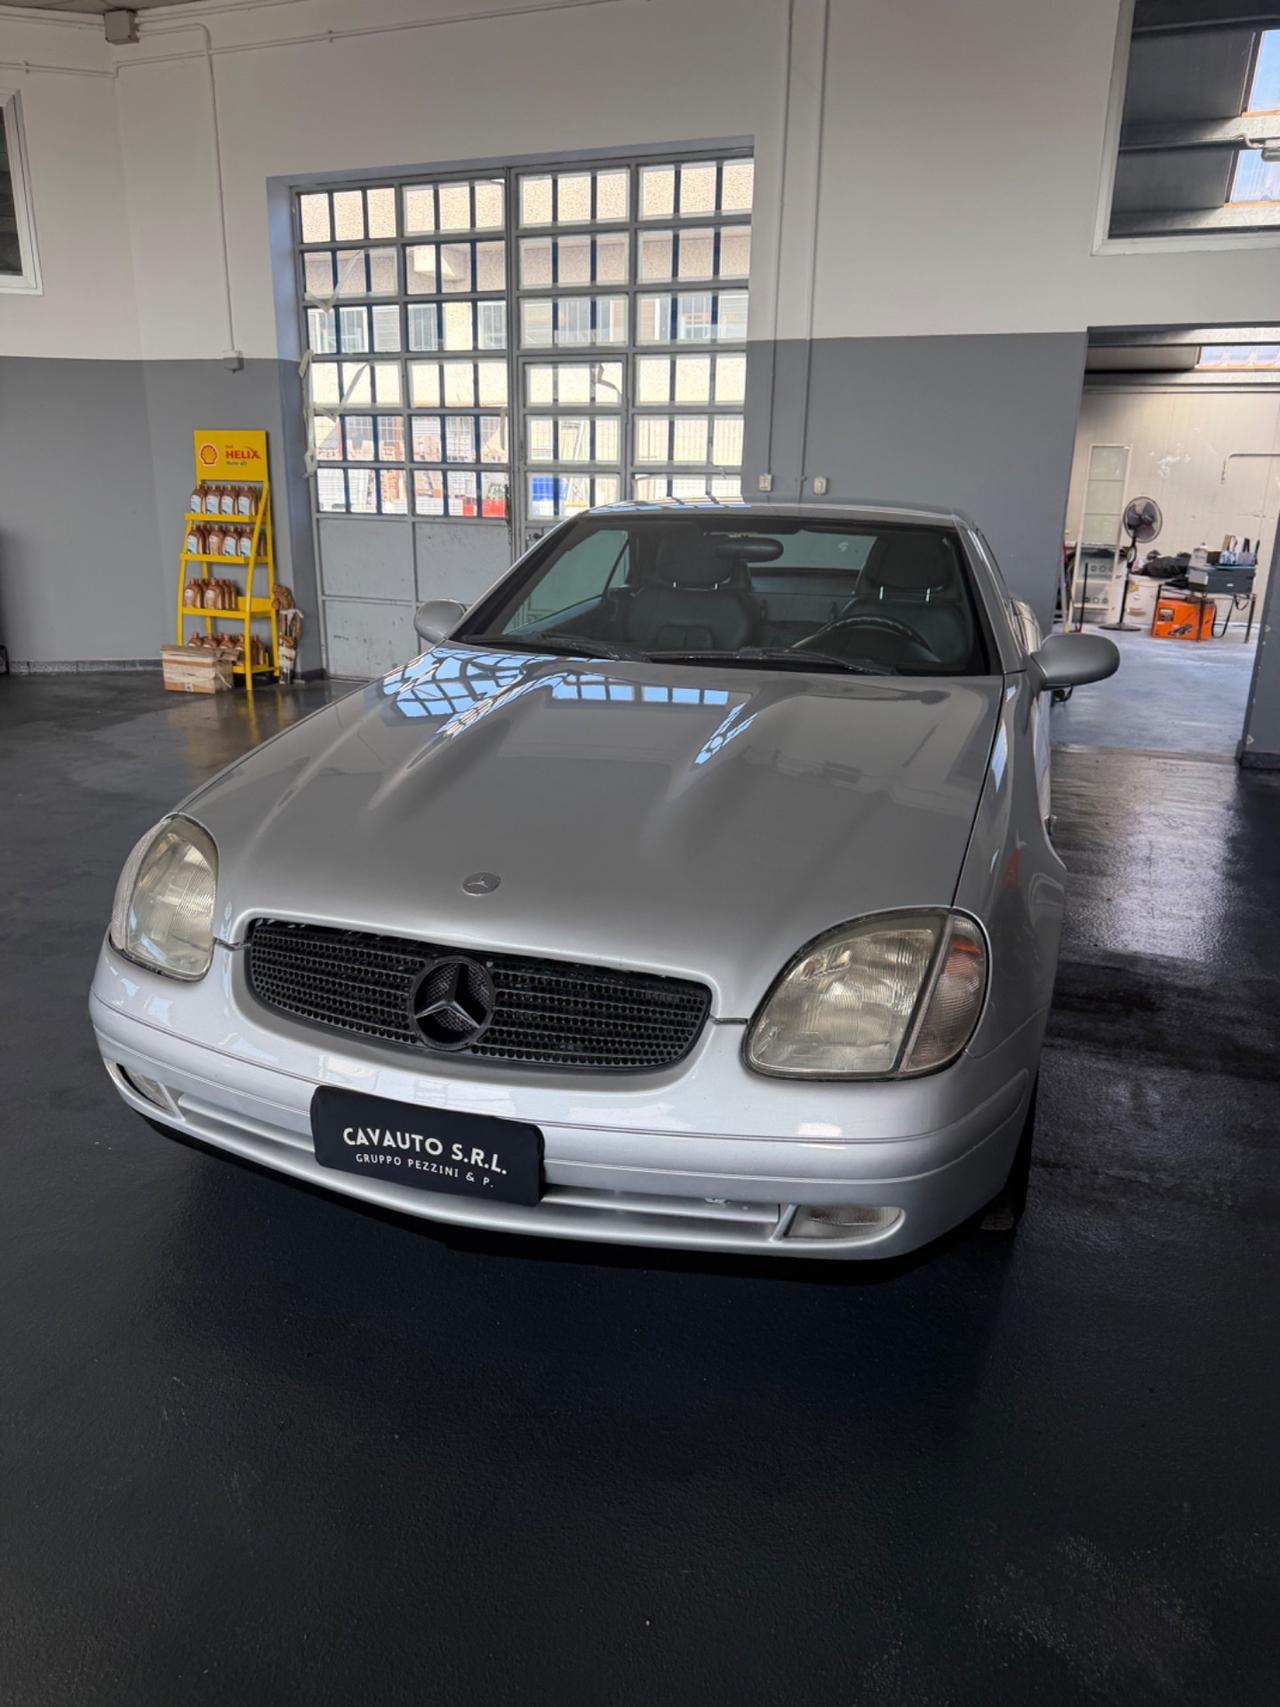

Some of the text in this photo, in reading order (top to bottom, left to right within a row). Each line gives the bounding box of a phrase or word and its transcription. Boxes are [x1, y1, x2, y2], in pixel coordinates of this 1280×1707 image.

[225, 450, 262, 459] HELIX
[343, 1127, 507, 1175] CAVAUTO S.R.L.
[355, 1153, 494, 1188] GRUPPO PEZZINI & P.
